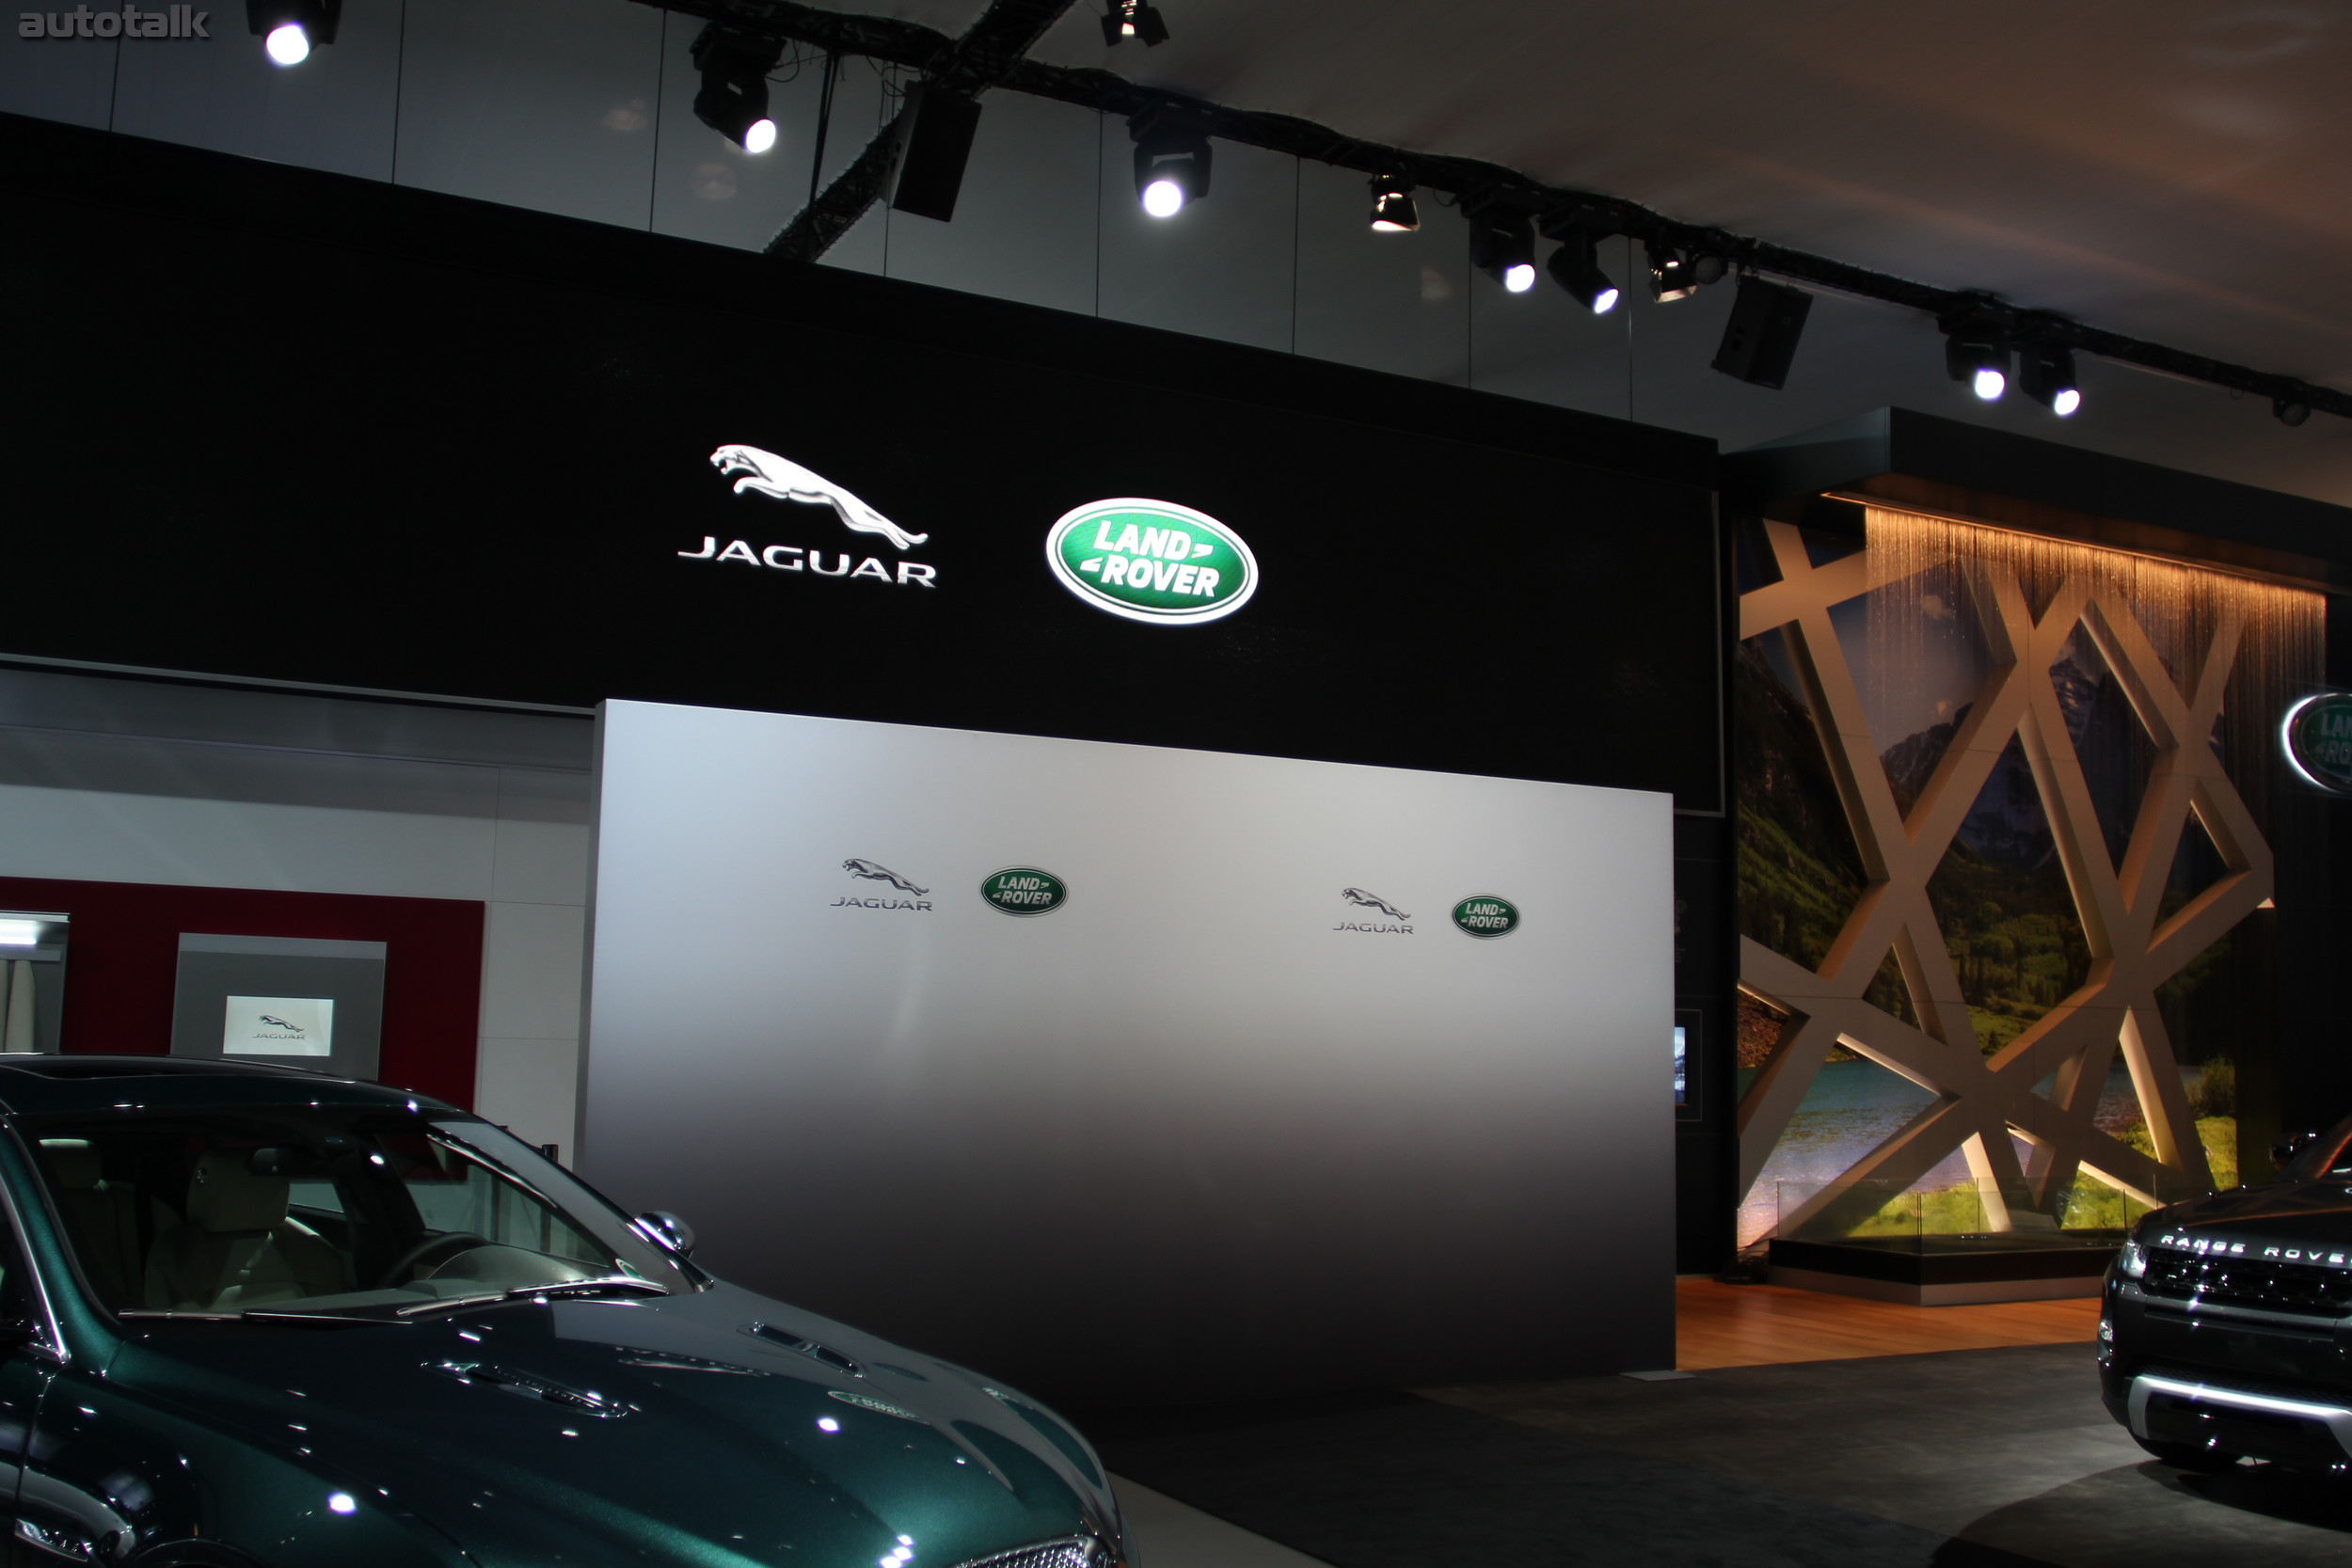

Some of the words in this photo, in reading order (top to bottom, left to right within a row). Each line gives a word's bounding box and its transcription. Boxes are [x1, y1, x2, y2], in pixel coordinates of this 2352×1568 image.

[1093, 519, 1192, 562] LAND
[677, 535, 937, 589] JAGUAR
[1100, 554, 1220, 598] ROVER
[2325, 738, 2352, 765] RO
[997, 875, 1041, 891] LAND
[830, 896, 933, 911] JAGUAR
[1000, 891, 1053, 906] ROVER
[1465, 902, 1499, 916] LAND
[1332, 922, 1414, 935] JAGUAR
[1467, 915, 1509, 929] ROVER
[2160, 1234, 2247, 1254] RANGE
[2264, 1245, 2352, 1265] ROVE
